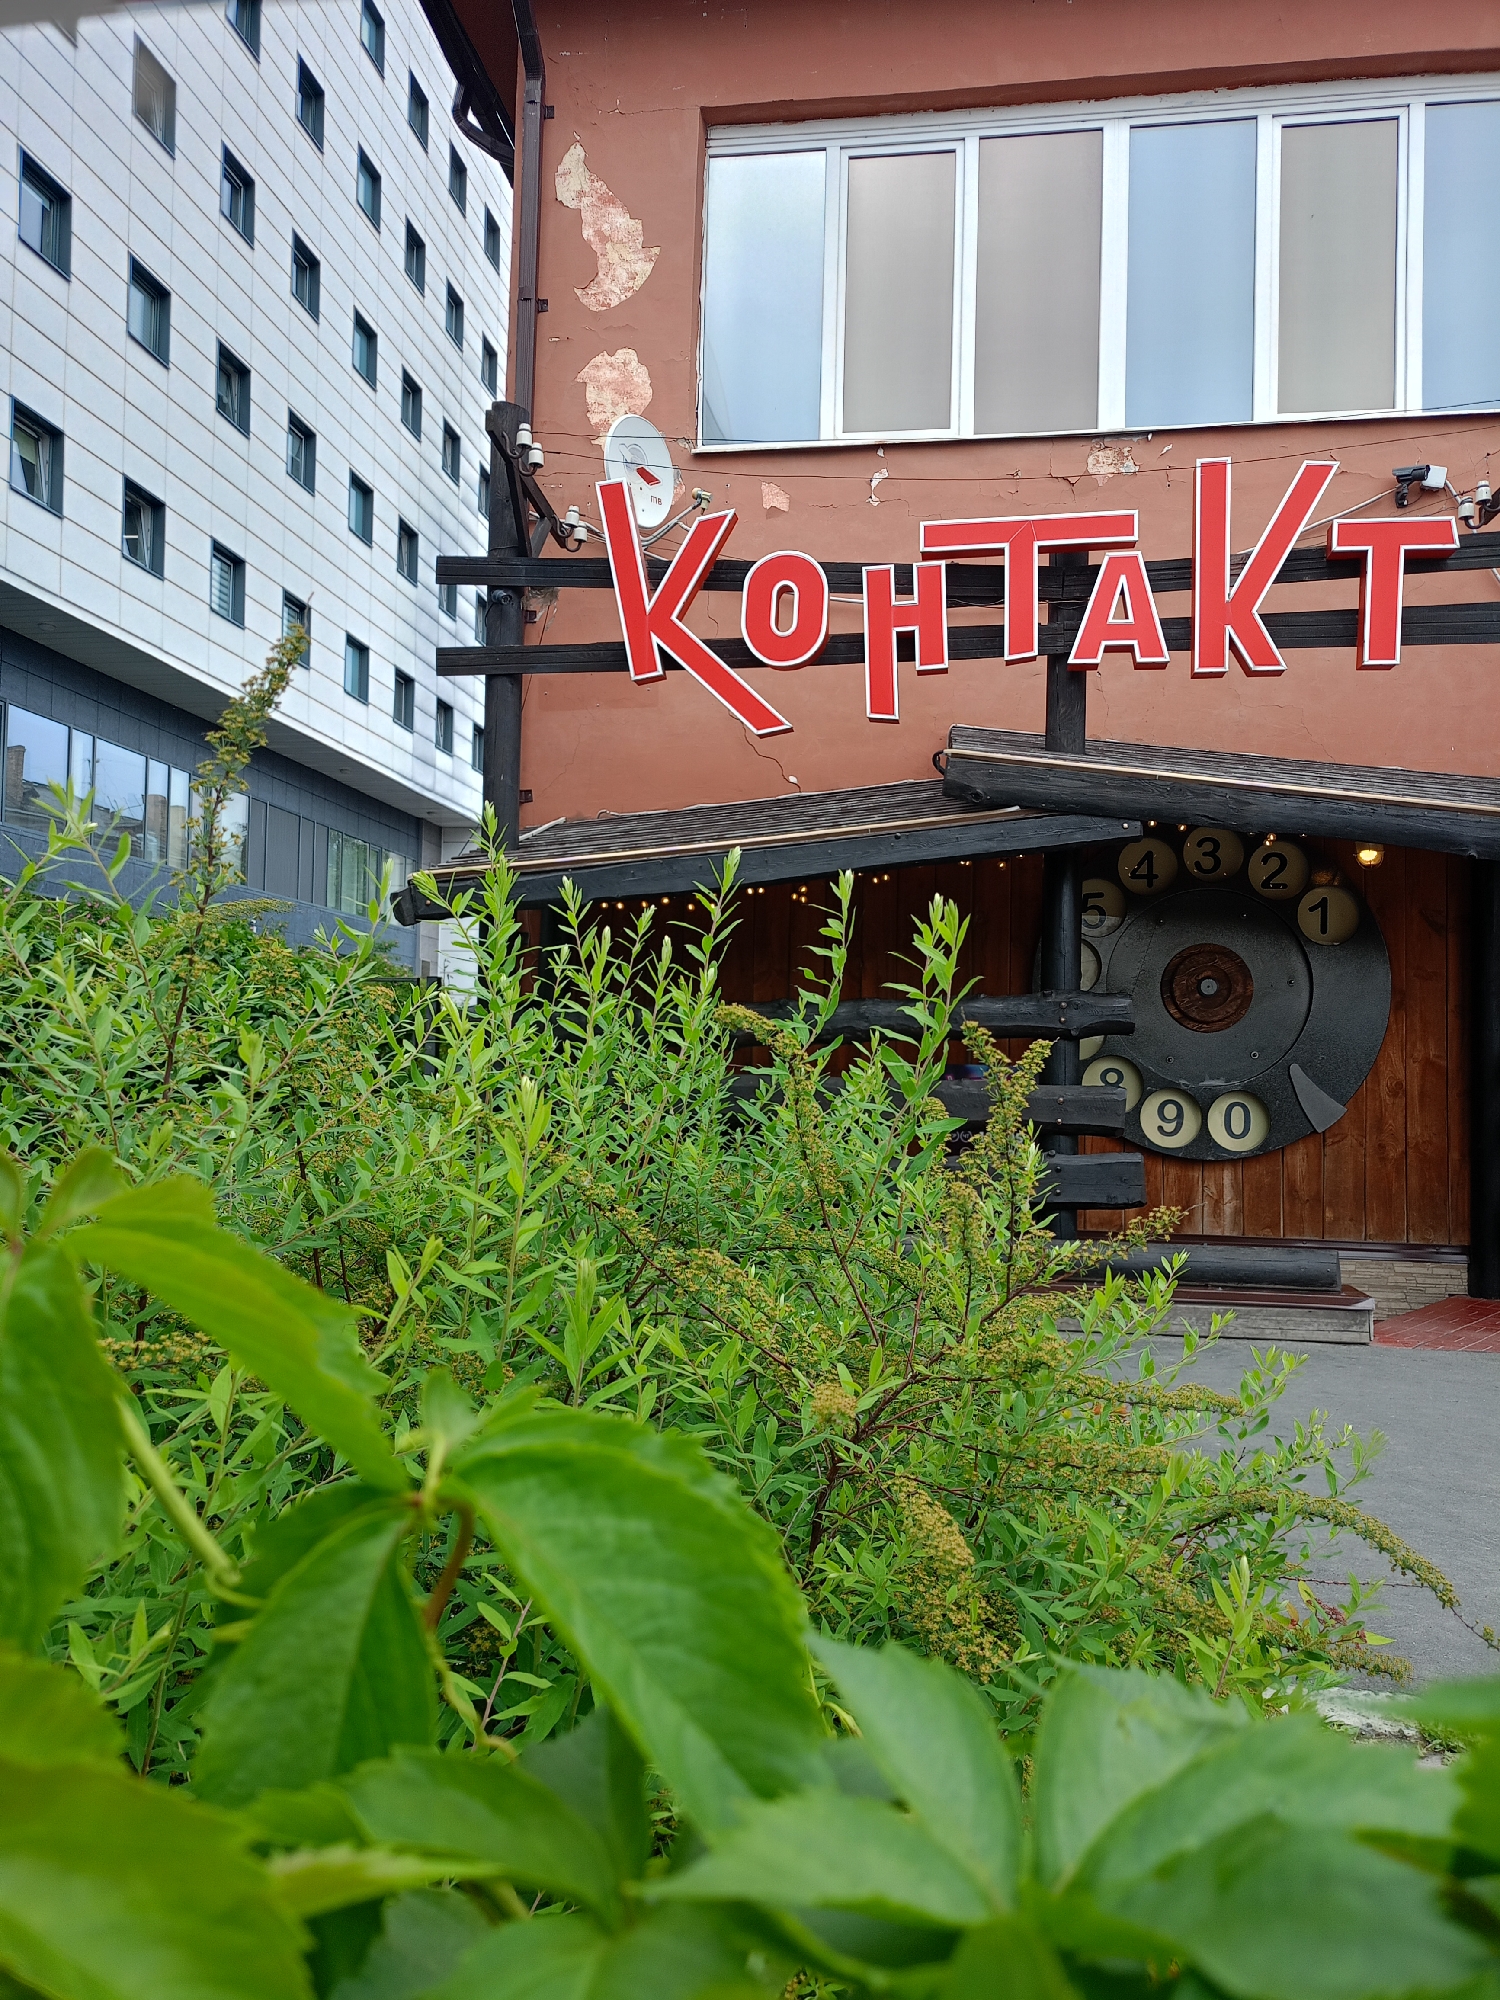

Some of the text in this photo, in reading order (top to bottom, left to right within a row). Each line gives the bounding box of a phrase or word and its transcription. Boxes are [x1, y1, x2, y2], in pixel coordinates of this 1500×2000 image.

[595, 457, 1460, 735] КОНТАКТ
[1129, 850, 1160, 889] 4
[1193, 836, 1222, 875] 3
[1260, 851, 1289, 890] 2
[1082, 892, 1107, 930] 5
[1307, 896, 1329, 935] 1
[1156, 1098, 1185, 1138] 9
[1223, 1101, 1251, 1140] 0
